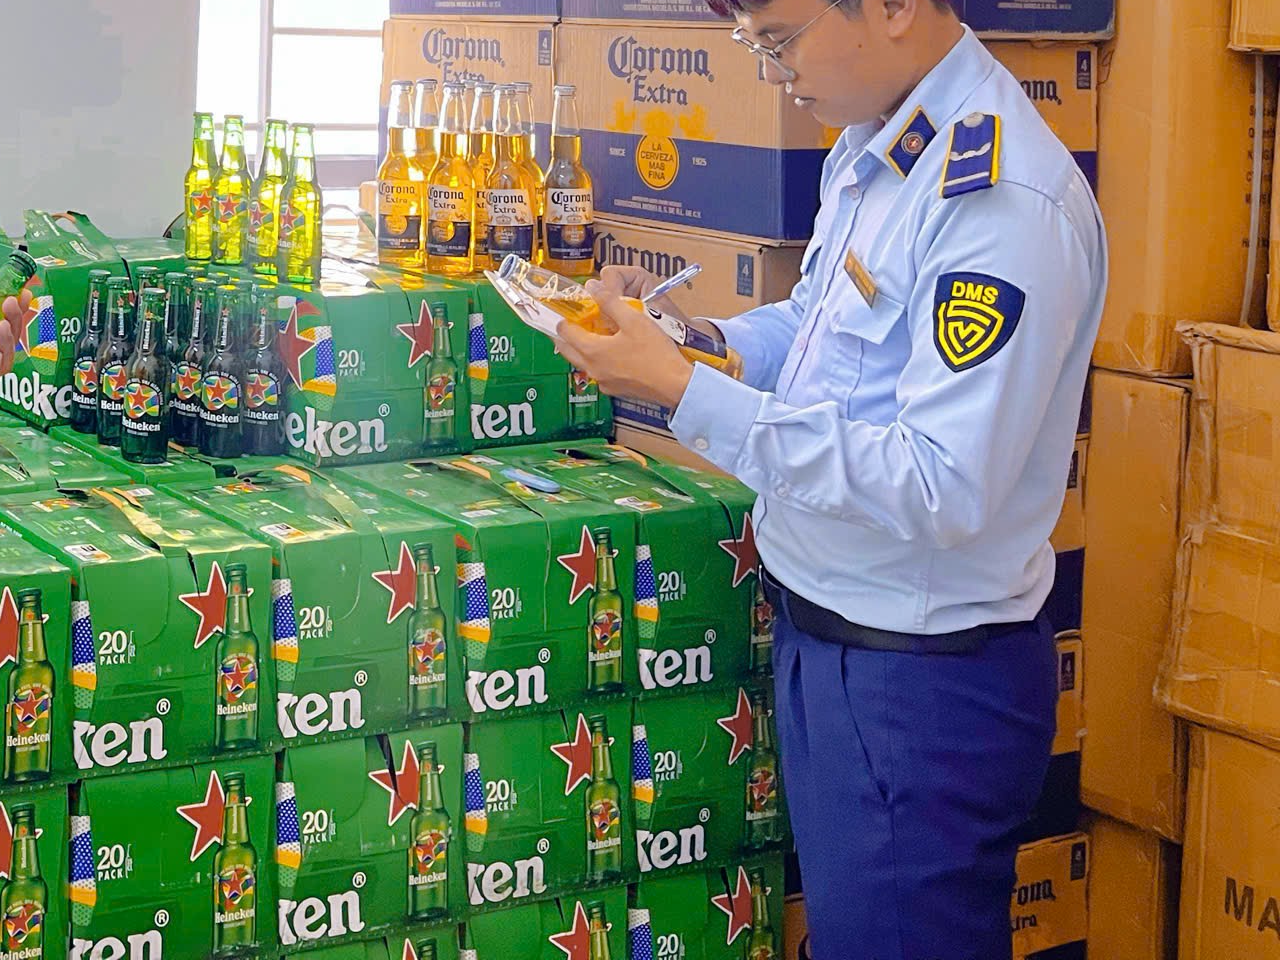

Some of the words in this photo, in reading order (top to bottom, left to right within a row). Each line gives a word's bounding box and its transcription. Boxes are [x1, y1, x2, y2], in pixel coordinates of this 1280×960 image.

[422, 28, 502, 69] Corona
[542, 37, 548, 49] 4
[608, 36, 710, 83] Corona
[1081, 59, 1088, 71] 4
[633, 75, 688, 106] Extra
[651, 143, 662, 151] LA
[640, 151, 674, 162] CERVEZA
[648, 171, 665, 181] FINA
[379, 183, 415, 195] Corona
[428, 187, 464, 200] Corona
[486, 192, 524, 205] Corona
[551, 191, 591, 205] Corona
[742, 263, 749, 276] 4
[951, 280, 999, 304] DMS
[60, 317, 80, 335] 20
[490, 336, 509, 353] 20
[338, 350, 359, 368] 20
[491, 354, 509, 362] PACK
[73, 392, 97, 404] Heine
[658, 571, 679, 592] 20
[492, 588, 515, 610] 20
[660, 591, 679, 602] PACK
[299, 606, 325, 629] 20
[493, 610, 514, 620] PACK
[301, 629, 324, 640] PACK
[99, 630, 127, 655] 20
[100, 654, 125, 665] PACK
[217, 703, 257, 715] Heineken
[7, 733, 50, 747] Heineken
[654, 751, 676, 772] 20
[486, 779, 509, 802] 20
[487, 801, 509, 812] PACK
[302, 809, 328, 834] 20
[97, 844, 124, 870] 20
[98, 869, 123, 881] PACK
[409, 872, 447, 885] Heineken
[215, 908, 255, 923] Heineken
[657, 934, 679, 955] 20
